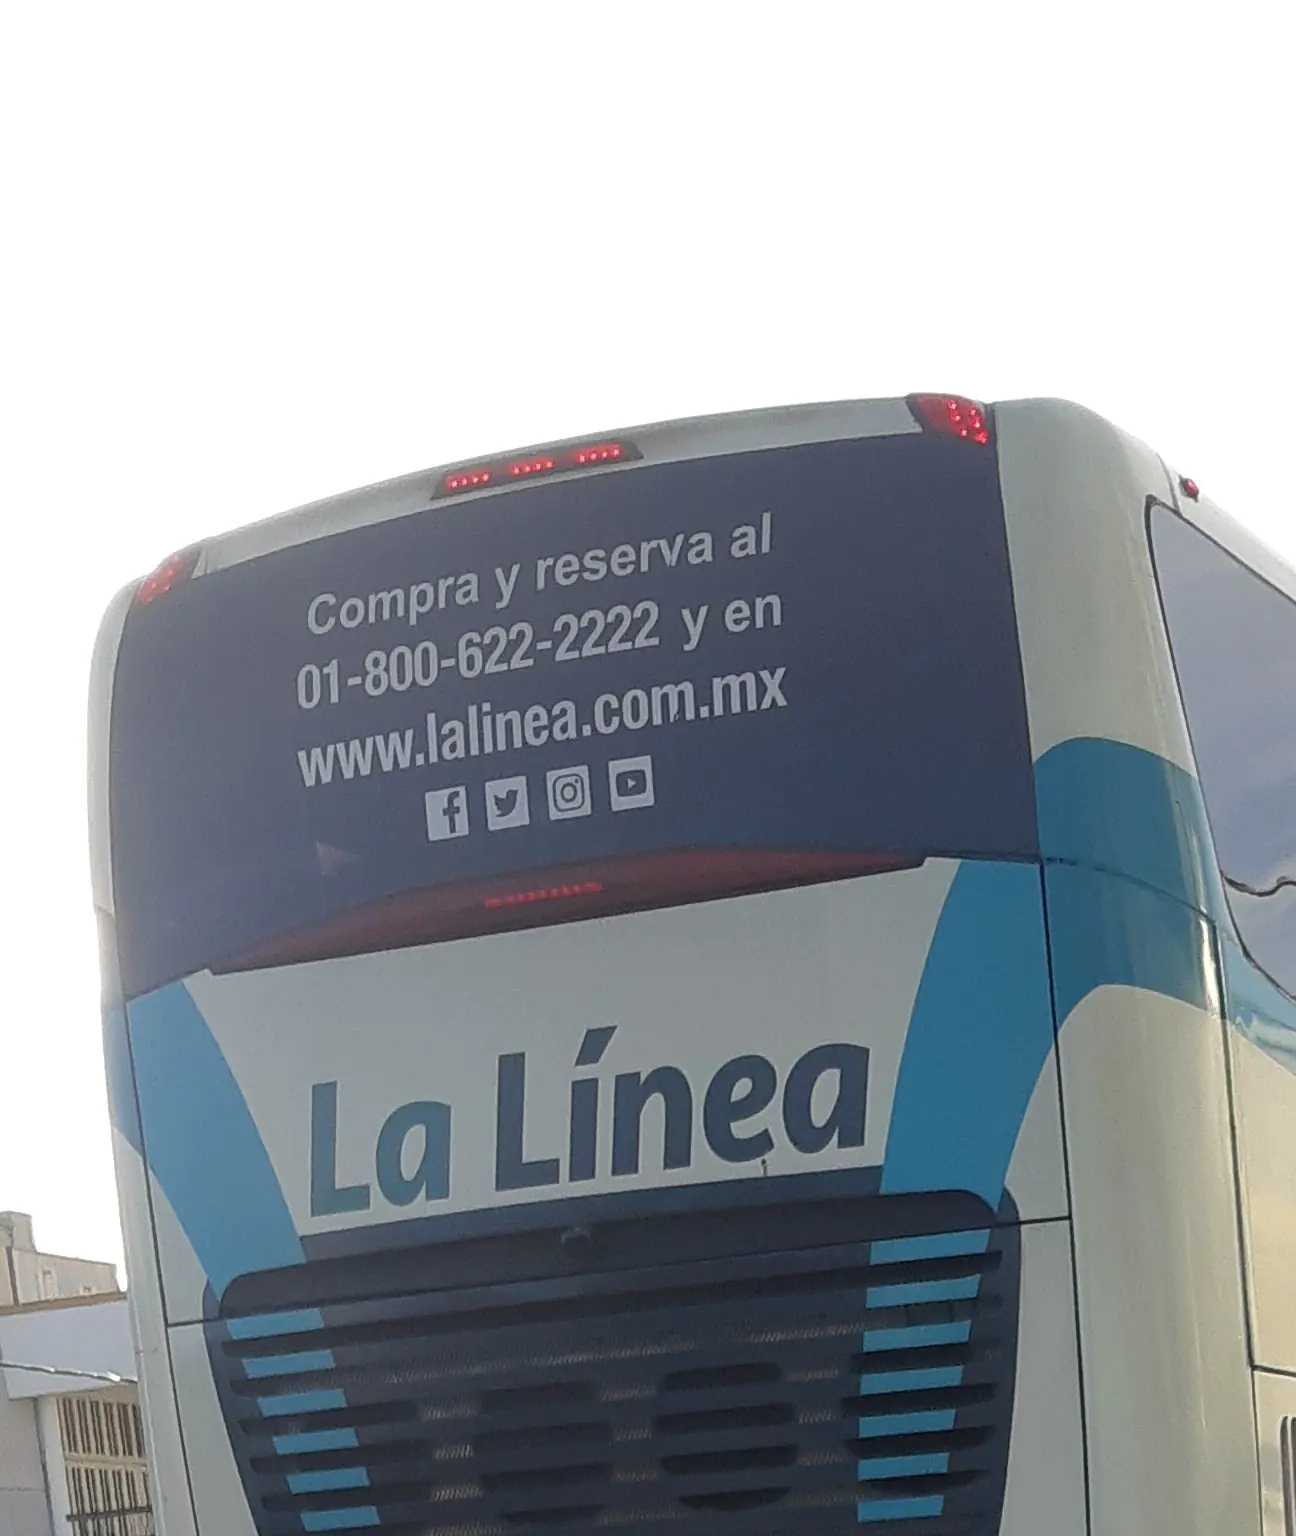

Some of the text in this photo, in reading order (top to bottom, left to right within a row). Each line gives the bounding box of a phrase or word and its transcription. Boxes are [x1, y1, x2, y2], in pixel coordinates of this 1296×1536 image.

[306, 512, 774, 636] Compra y reserva al
[296, 594, 783, 710] 01-800-622-2222 y en
[297, 666, 788, 787] www.lalinea.com.mx
[310, 1025, 871, 1218] La Línea
